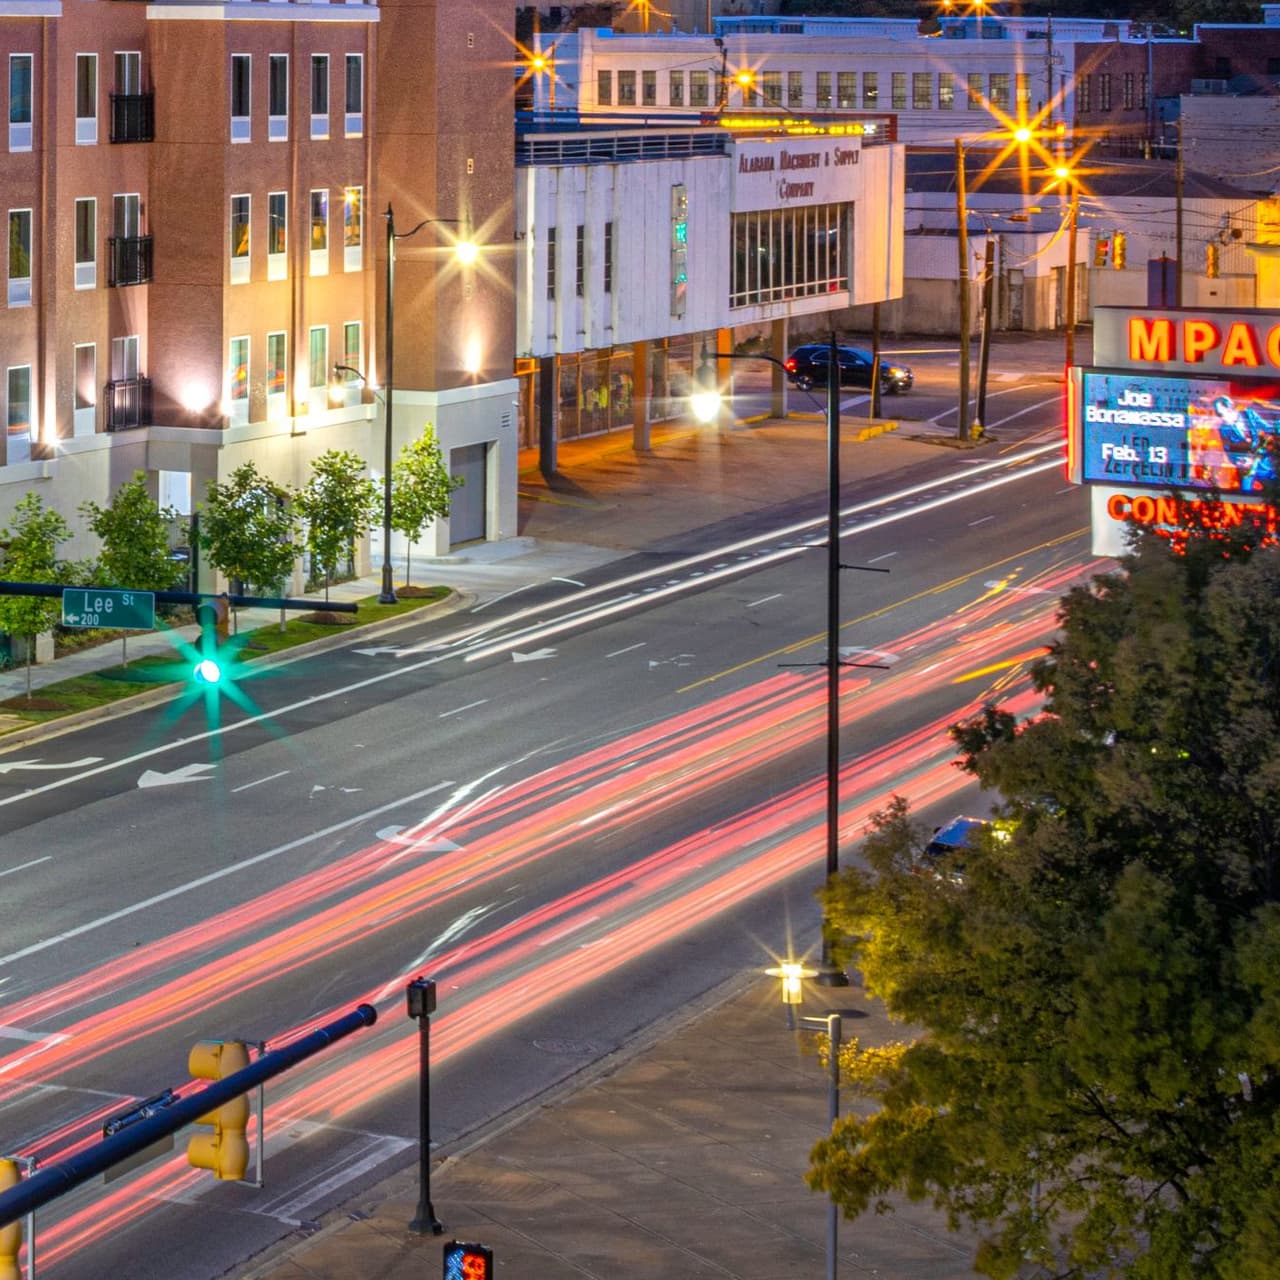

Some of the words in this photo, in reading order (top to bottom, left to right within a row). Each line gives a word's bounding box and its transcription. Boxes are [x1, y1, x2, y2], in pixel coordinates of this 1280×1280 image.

[1118, 390, 1152, 407] Joe
[1101, 443, 1140, 461] Feb.
[1148, 446, 1169, 463] 13
[84, 592, 113, 613] Lee
[122, 593, 134, 606] St
[81, 613, 99, 625] 200
